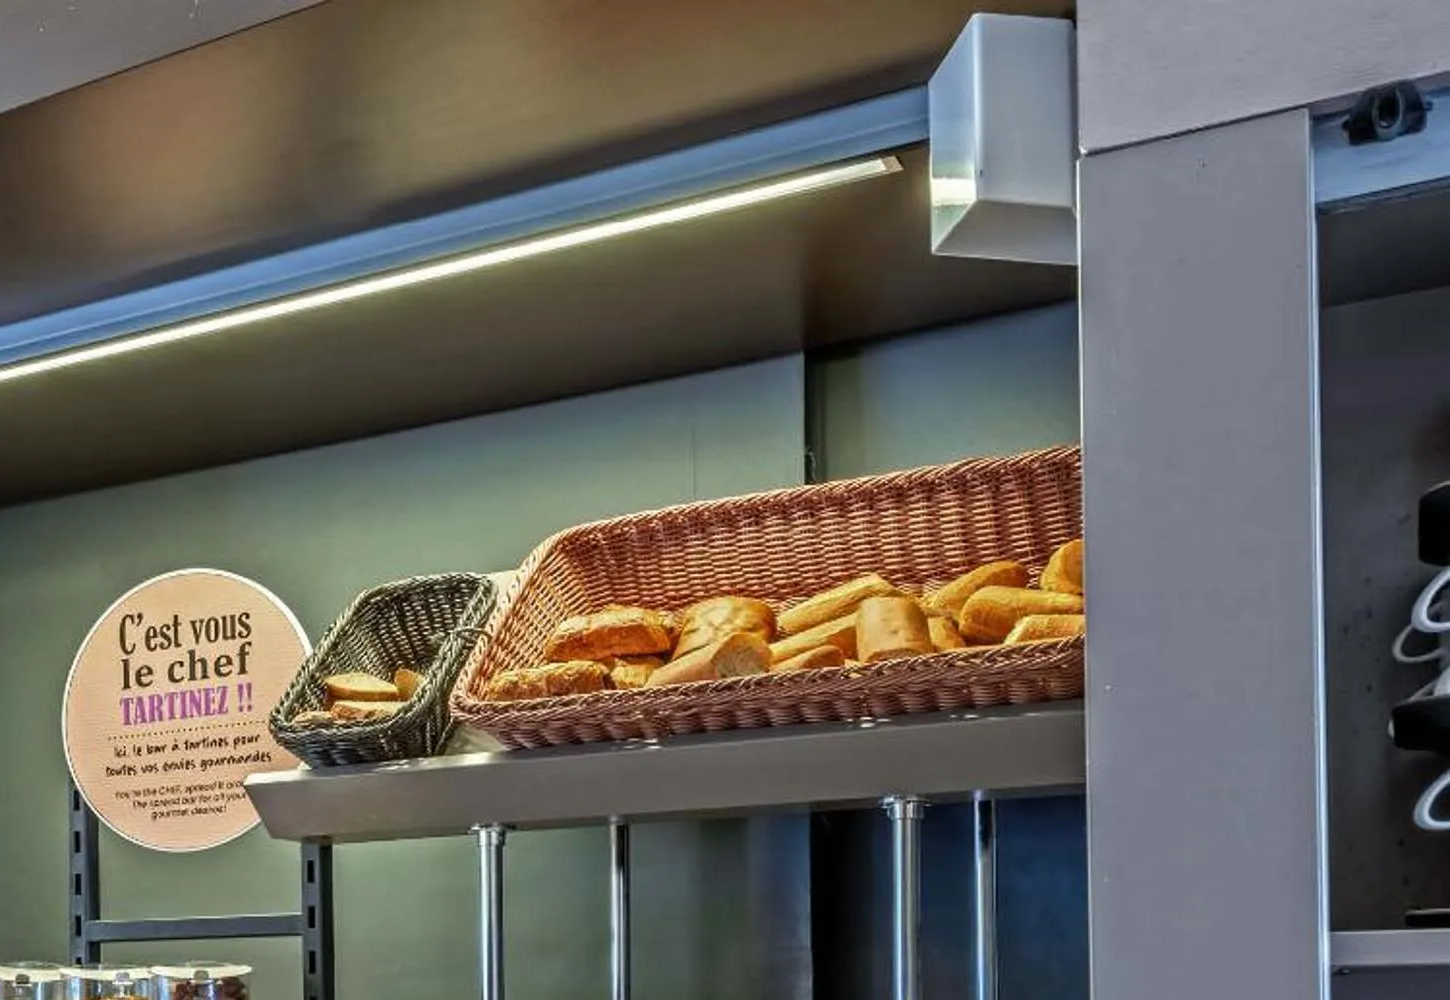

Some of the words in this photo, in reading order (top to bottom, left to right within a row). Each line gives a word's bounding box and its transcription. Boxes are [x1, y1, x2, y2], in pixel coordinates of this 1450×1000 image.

[119, 612, 182, 655] C'est
[190, 612, 252, 646] vous
[121, 658, 153, 691] le
[168, 641, 252, 683] chef
[120, 686, 229, 726] TARTINEZ
[133, 744, 142, 757] le
[146, 743, 167, 755] bar
[184, 736, 229, 750] tartines
[233, 734, 261, 749] pour
[141, 763, 159, 774] vos
[162, 757, 196, 772] envies
[200, 750, 272, 771] gourmandes
